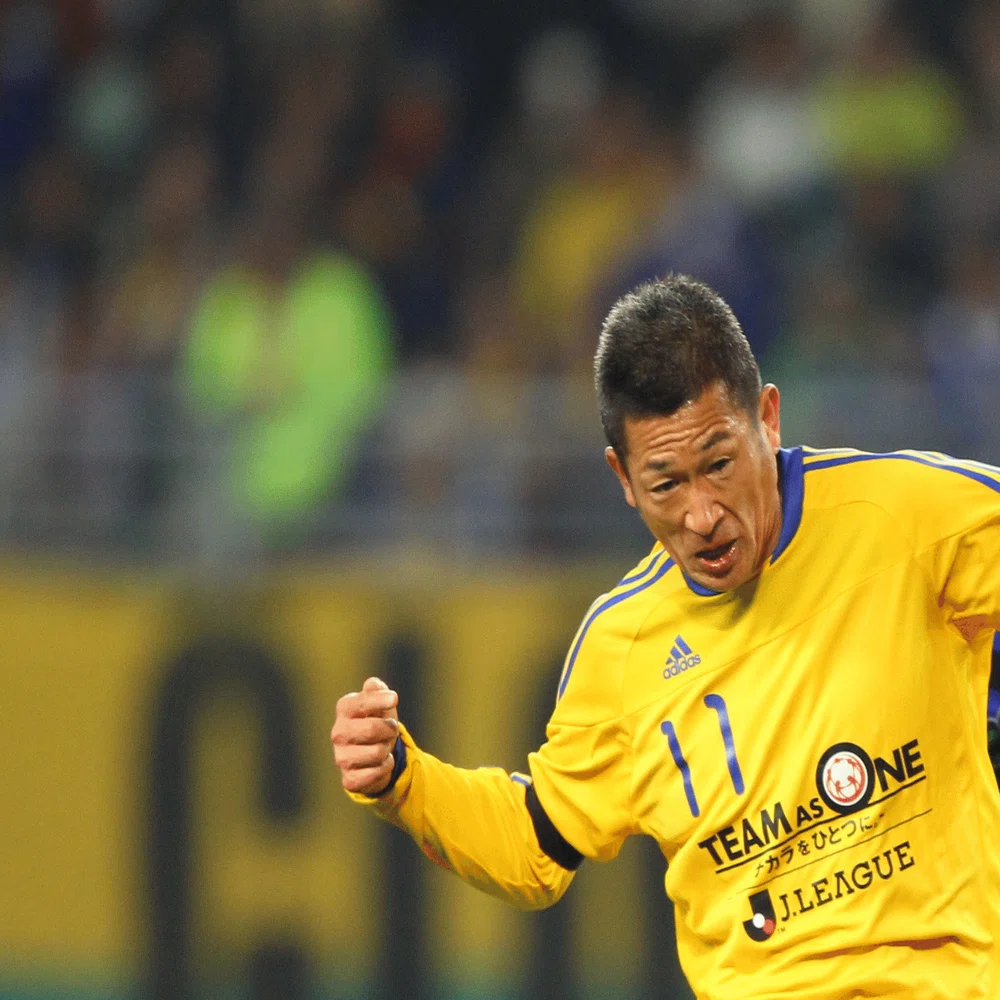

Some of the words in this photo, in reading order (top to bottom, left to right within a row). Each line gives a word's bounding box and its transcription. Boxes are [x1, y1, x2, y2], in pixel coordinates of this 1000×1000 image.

[663, 655, 702, 680] adidas
[660, 693, 745, 818] 11
[698, 802, 793, 866] TEAM
[796, 798, 824, 828] AS
[815, 739, 925, 816] ONE
[779, 841, 915, 922] J.LEAGUE
